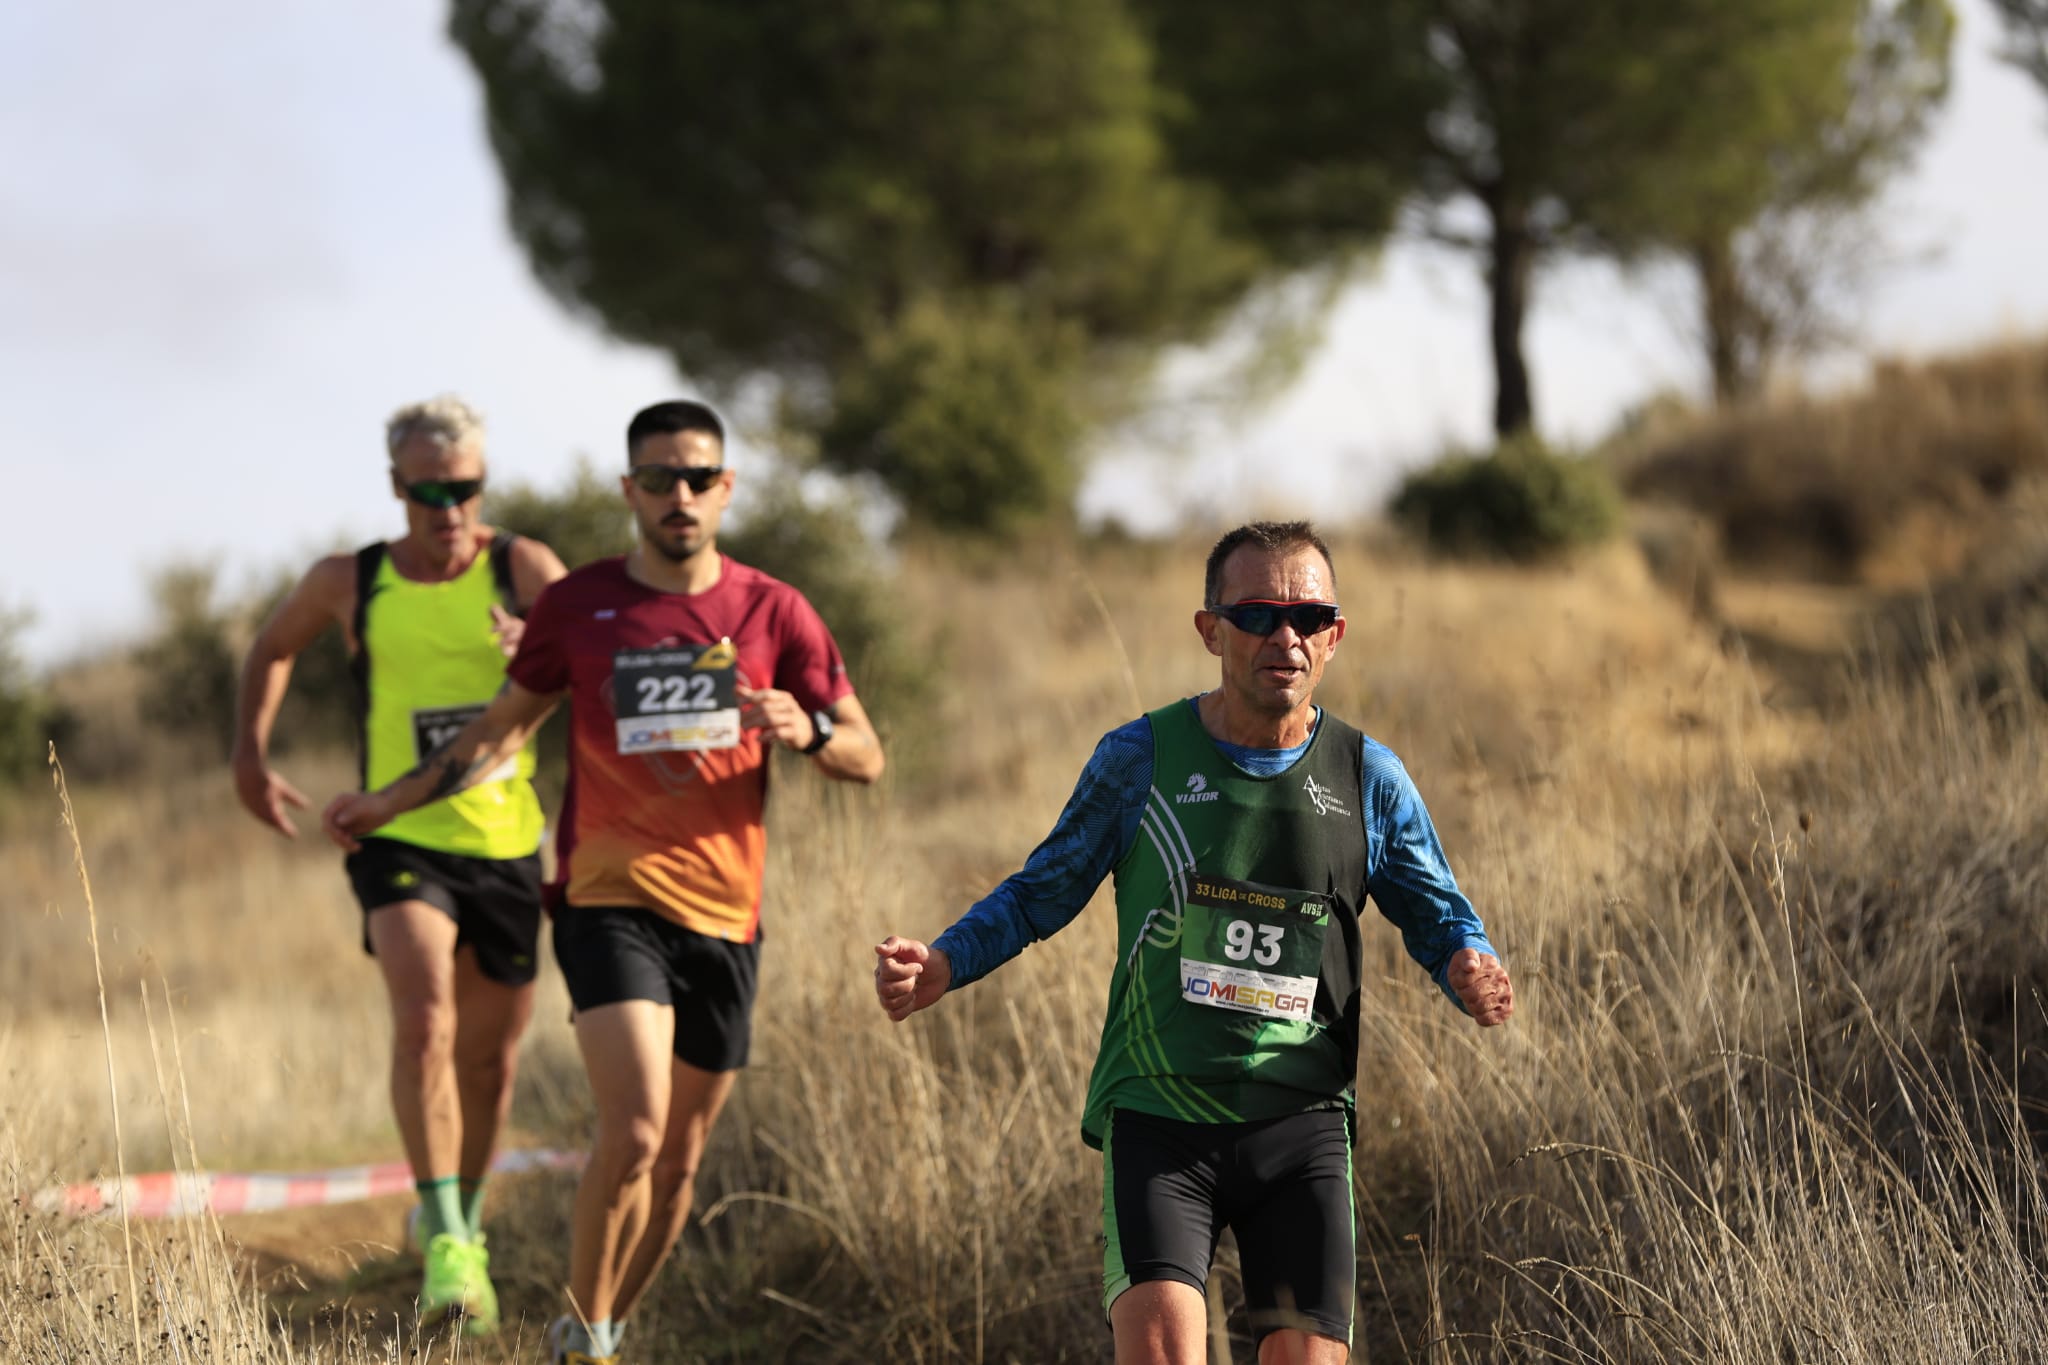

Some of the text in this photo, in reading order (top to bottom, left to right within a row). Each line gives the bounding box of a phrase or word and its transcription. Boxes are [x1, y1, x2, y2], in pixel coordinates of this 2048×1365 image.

[636, 673, 718, 713] 222
[1175, 791, 1219, 804] VIATOR
[1195, 883, 1210, 896] 33
[1211, 885, 1238, 901] LIGA
[1247, 892, 1287, 910] CROSS
[1300, 902, 1318, 916] AVS
[1224, 919, 1285, 967] 93
[1183, 977, 1309, 1014] JOMISAGA
